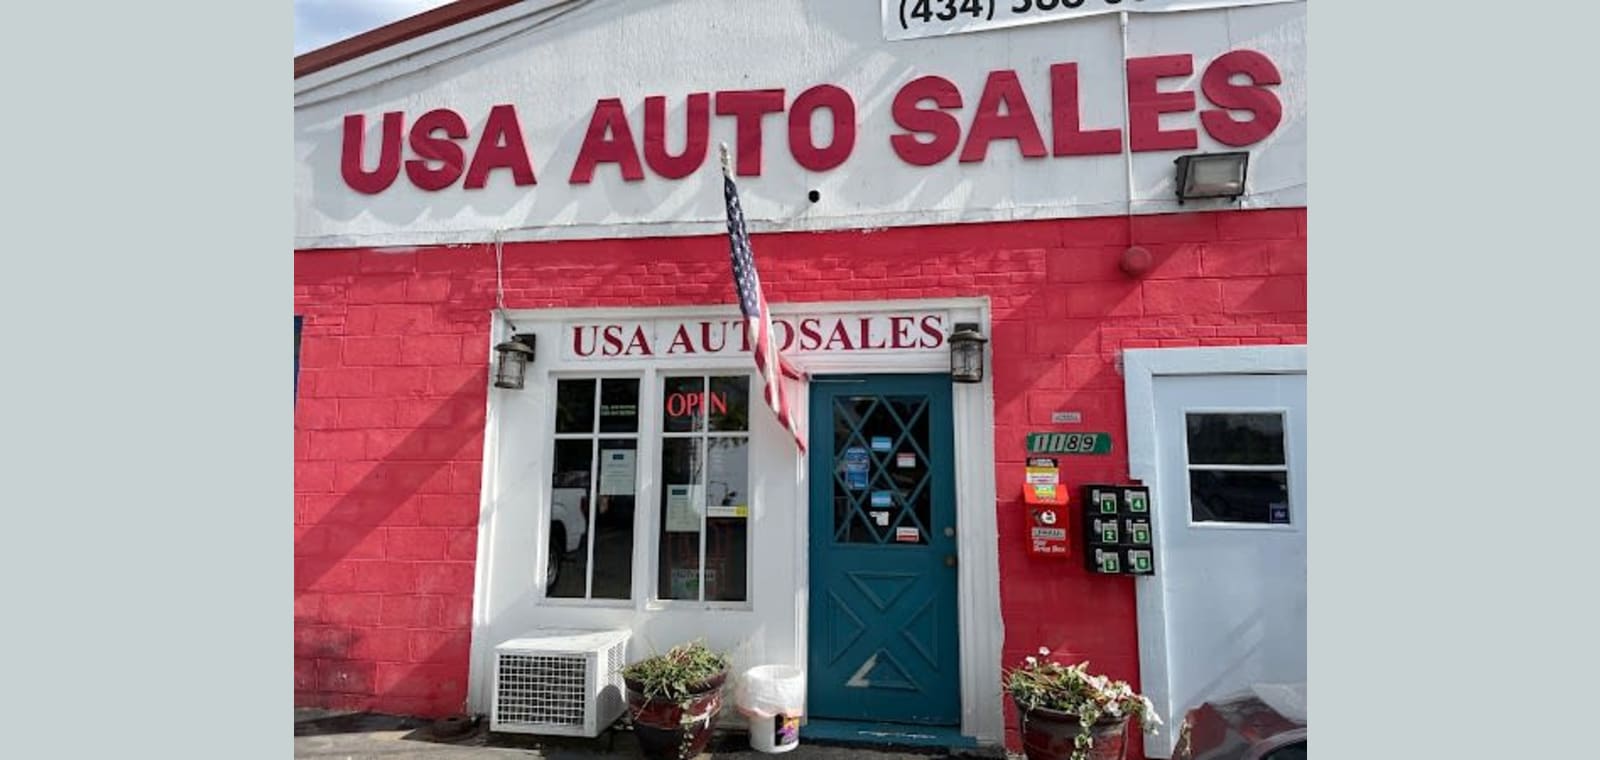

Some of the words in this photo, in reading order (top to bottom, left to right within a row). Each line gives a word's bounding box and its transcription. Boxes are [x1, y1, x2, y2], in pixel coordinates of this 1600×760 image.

[340, 104, 537, 195] USA
[569, 84, 857, 185] AUTO
[890, 49, 1282, 166] SALES
[572, 325, 654, 357] USA
[1038, 435, 1094, 450] 1189
